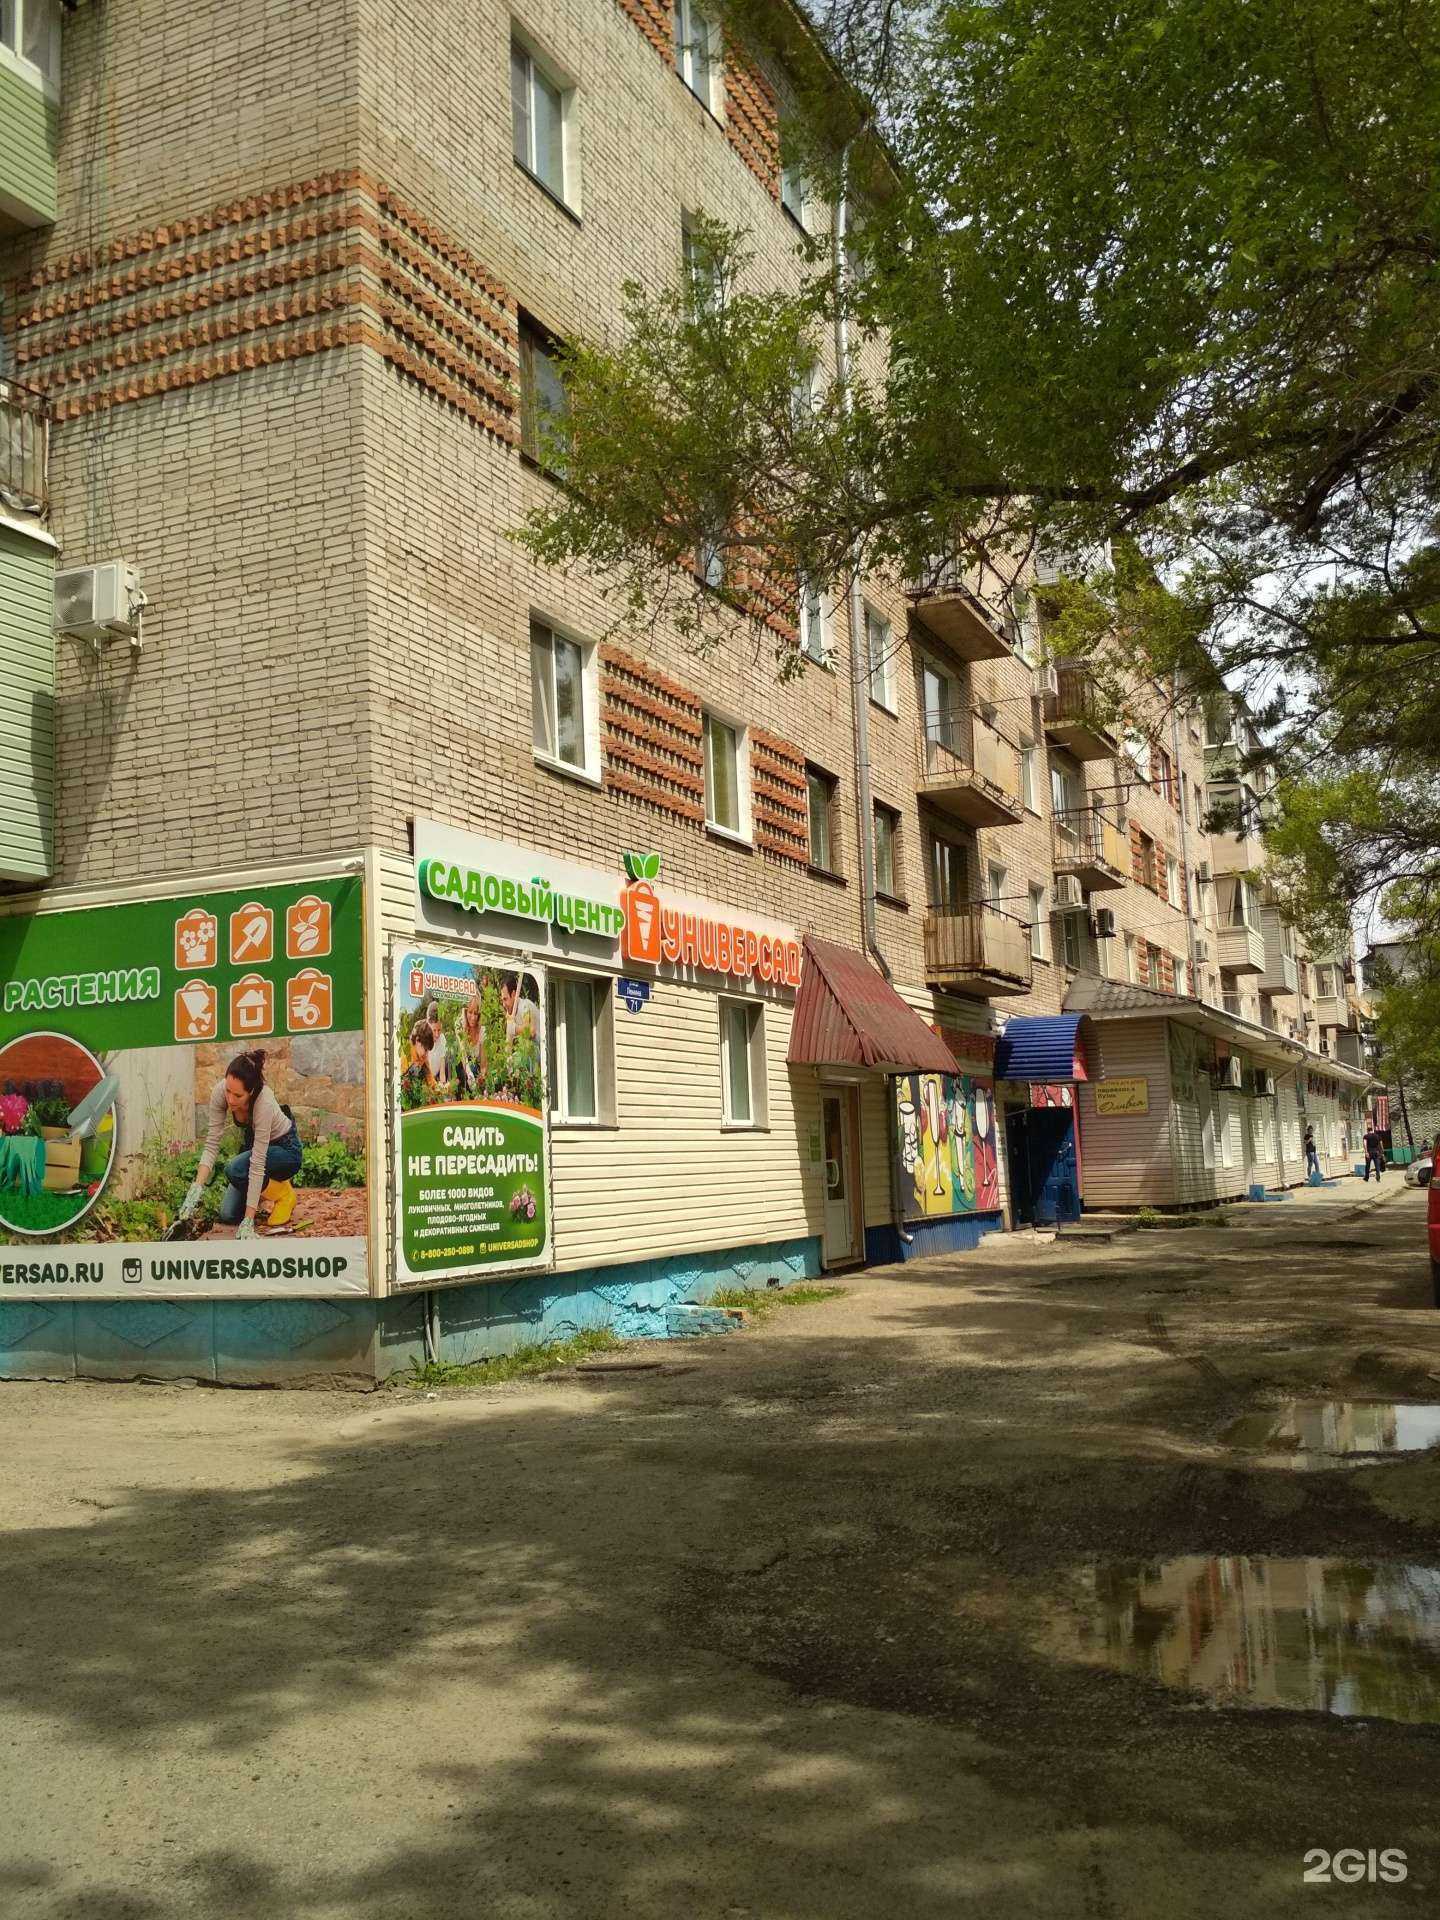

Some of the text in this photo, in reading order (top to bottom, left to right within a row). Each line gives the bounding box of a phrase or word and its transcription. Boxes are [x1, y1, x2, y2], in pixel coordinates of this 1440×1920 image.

[424, 857, 626, 938] САДОВЫЙ ЦЕНТР
[660, 906, 802, 988] УНИВЕРСАД
[4, 966, 160, 1012] РАСТЕНИЯ
[425, 972, 477, 996] УНИВЕРСАД
[630, 999, 638, 1012] 71
[443, 1126, 505, 1150] САДИТЬ
[408, 1153, 538, 1177] НЕ ПЕРЕСАДИТЬ!
[419, 1187, 494, 1201] БОЛЕЕ 1000 ВИДОВ
[427, 1212, 487, 1225] ПЛОДОВО-ЯГОДНЫХ
[413, 1228, 419, 1238] И
[419, 1225, 469, 1238] ДЕКОРАТИВНЫХ
[487, 1238, 539, 1253] UNIVERSADSHOP
[0, 1256, 348, 1284] ERSAD.RU UNIVERSADSHOP
